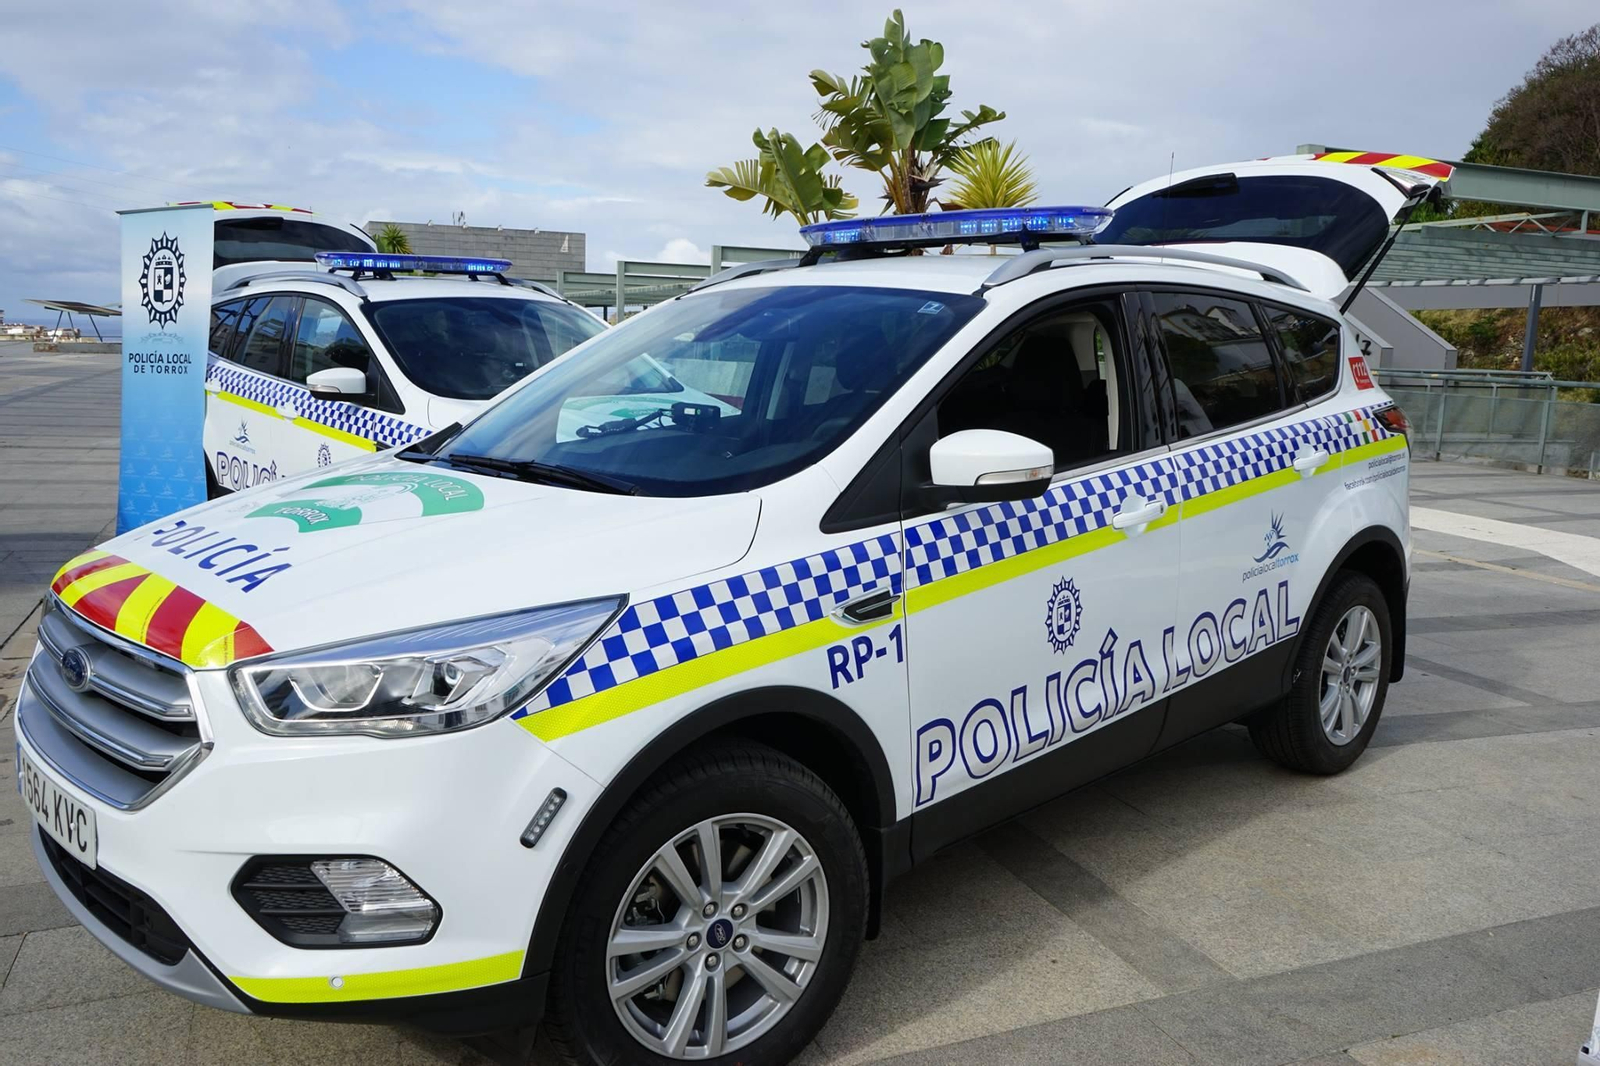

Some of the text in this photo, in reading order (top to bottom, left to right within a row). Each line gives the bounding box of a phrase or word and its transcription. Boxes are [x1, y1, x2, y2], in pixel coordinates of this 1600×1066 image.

[128, 350, 192, 365] POLICÍA LOCAL
[133, 364, 189, 375] DE TORROX
[216, 451, 286, 492] POLICÍ
[423, 476, 469, 502] LOCAL
[274, 506, 331, 525] TORROX
[152, 519, 293, 594] POLICÍA
[827, 624, 905, 690] RP-1
[914, 580, 1301, 808] POLICÍA LOCAL
[22, 757, 88, 853] 1564 KVC
